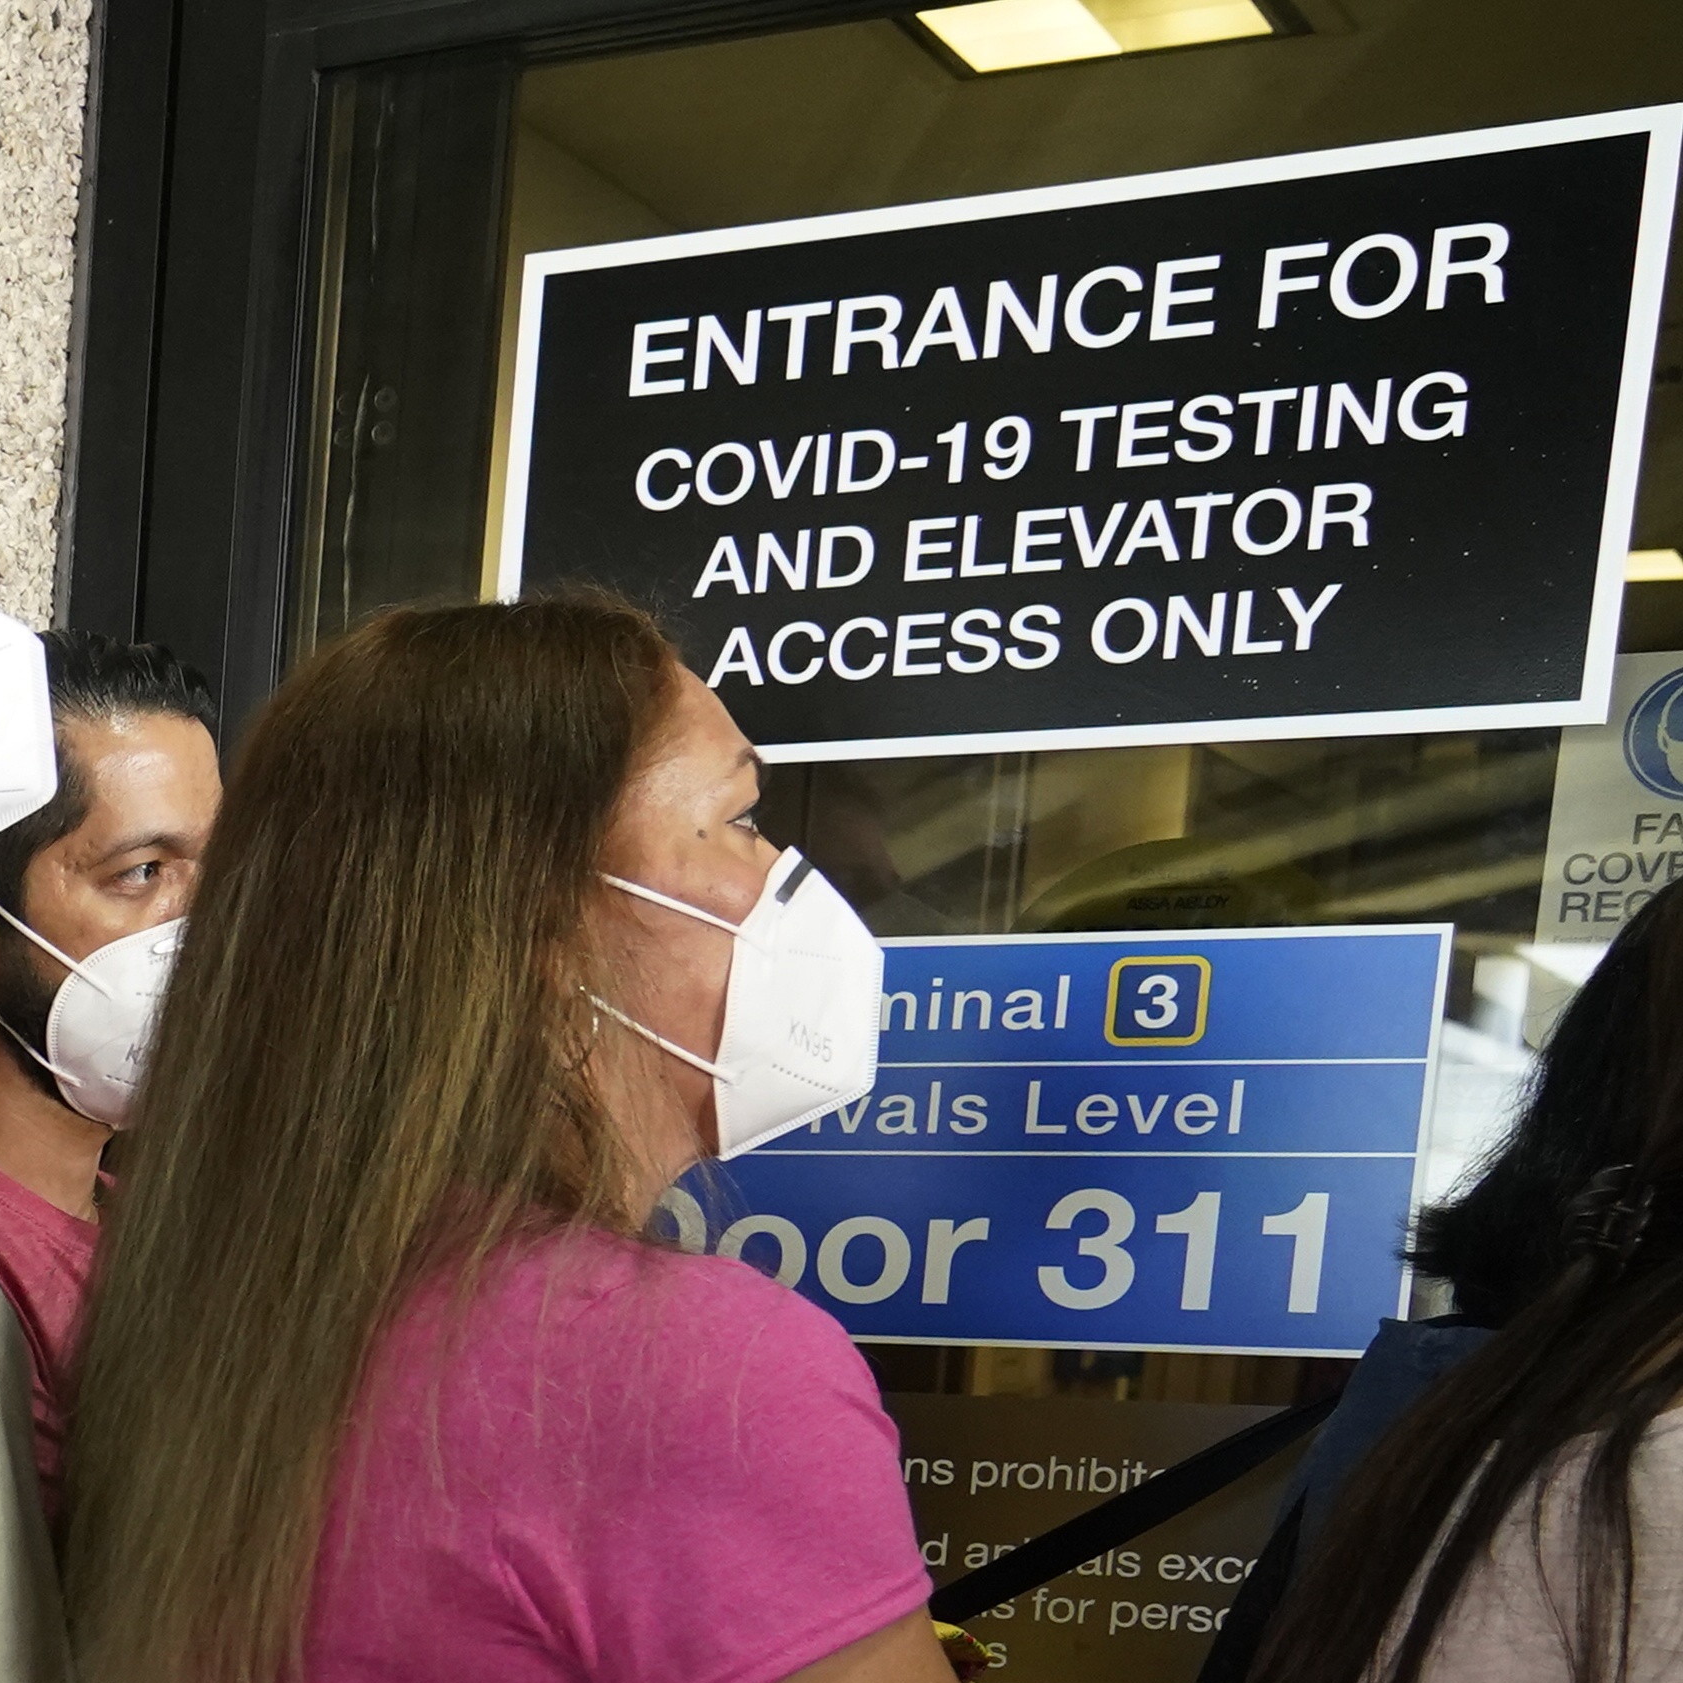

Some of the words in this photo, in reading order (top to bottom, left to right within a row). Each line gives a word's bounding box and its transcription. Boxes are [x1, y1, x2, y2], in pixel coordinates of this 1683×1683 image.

[628, 254, 1222, 398] ENTRANCE
[1257, 222, 1511, 330] FOR
[635, 415, 1032, 512] COVID-19
[1059, 371, 1469, 472] TESTING
[691, 525, 875, 599] AND
[903, 482, 1373, 583] ELEVATOR
[707, 604, 1062, 690] ACCESS
[1090, 583, 1343, 664] ONLY
[881, 974, 1071, 1031] minal
[1134, 975, 1179, 1030] 3
[1025, 1079, 1246, 1136] Level
[1037, 1188, 1331, 1314] 311
[1031, 1587, 1096, 1624] for
